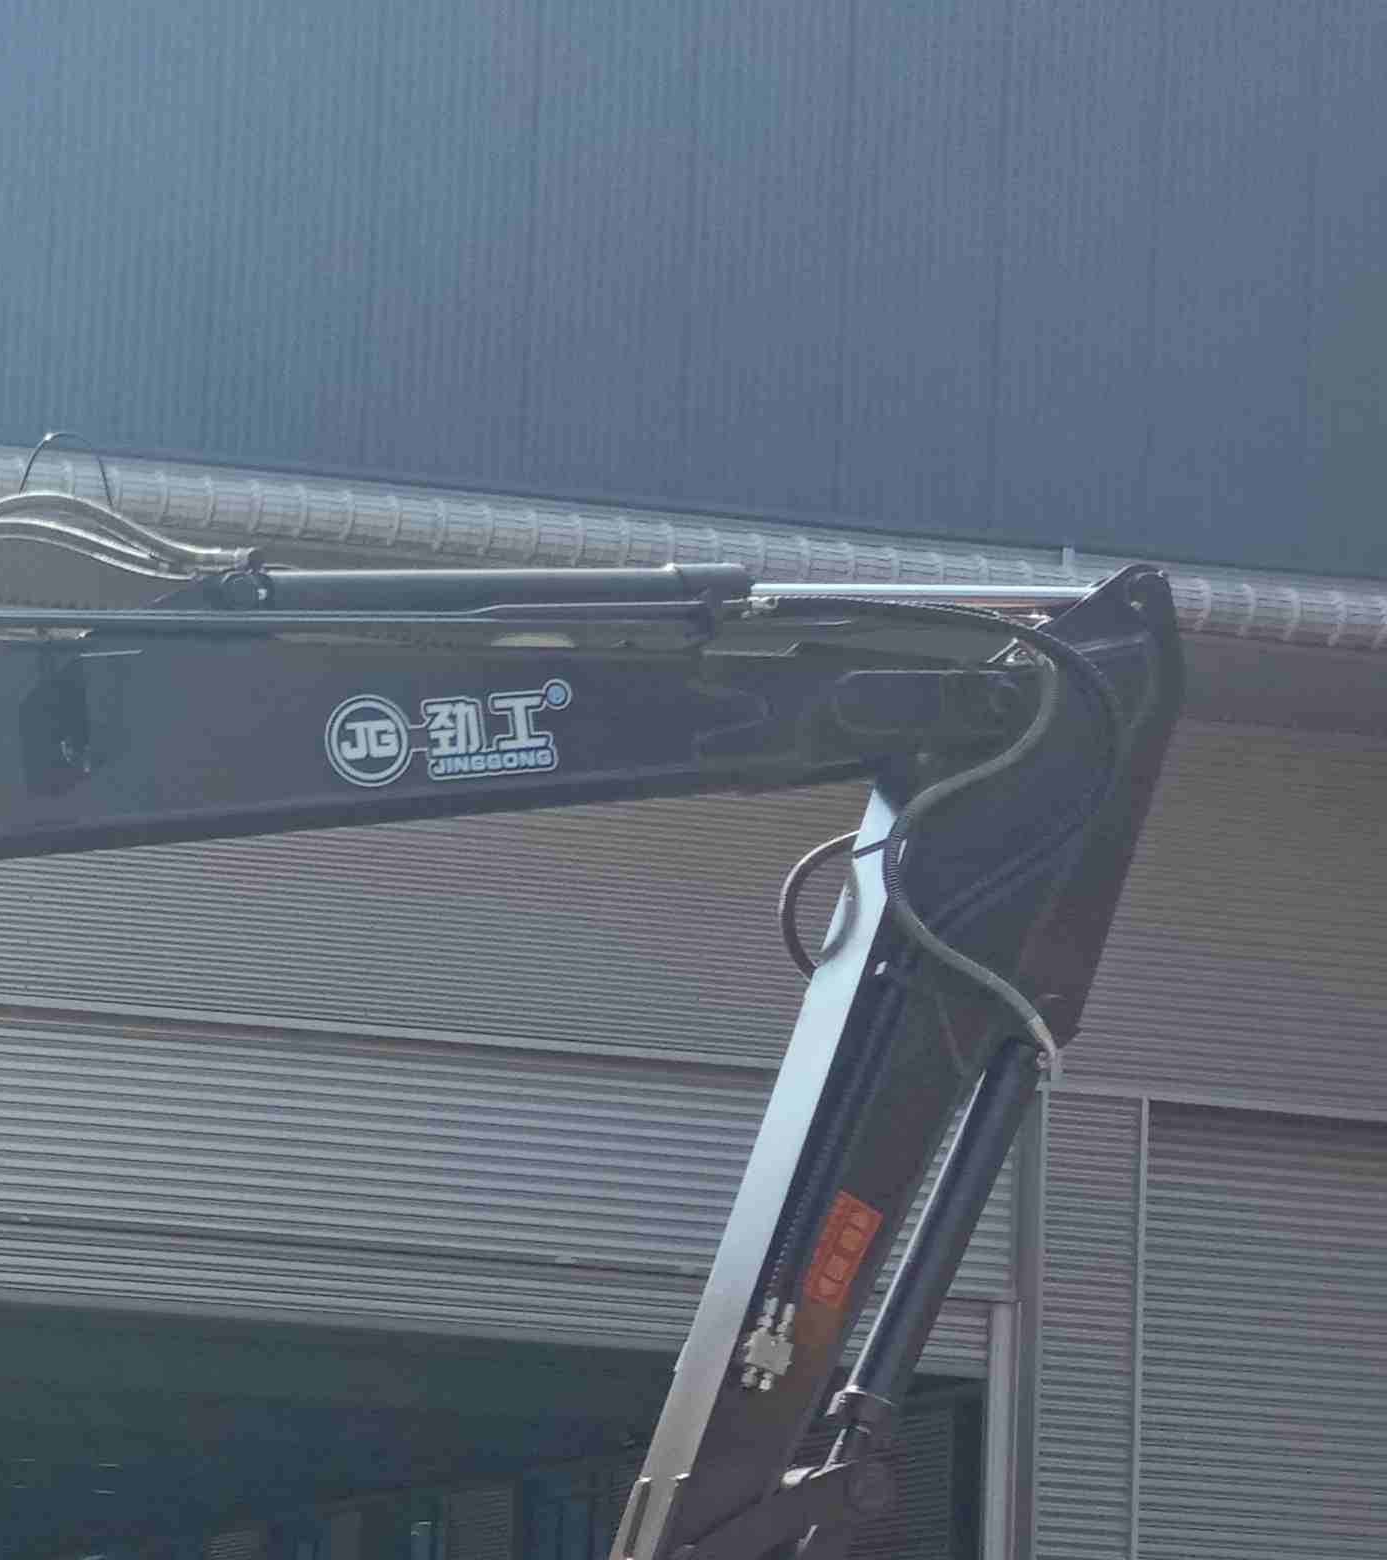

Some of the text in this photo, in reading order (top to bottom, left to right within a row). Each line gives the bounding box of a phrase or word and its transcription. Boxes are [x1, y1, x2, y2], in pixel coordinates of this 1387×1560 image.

[340, 719, 400, 760] JG
[427, 696, 547, 757] 劲工
[432, 749, 552, 774] JINGGONG
